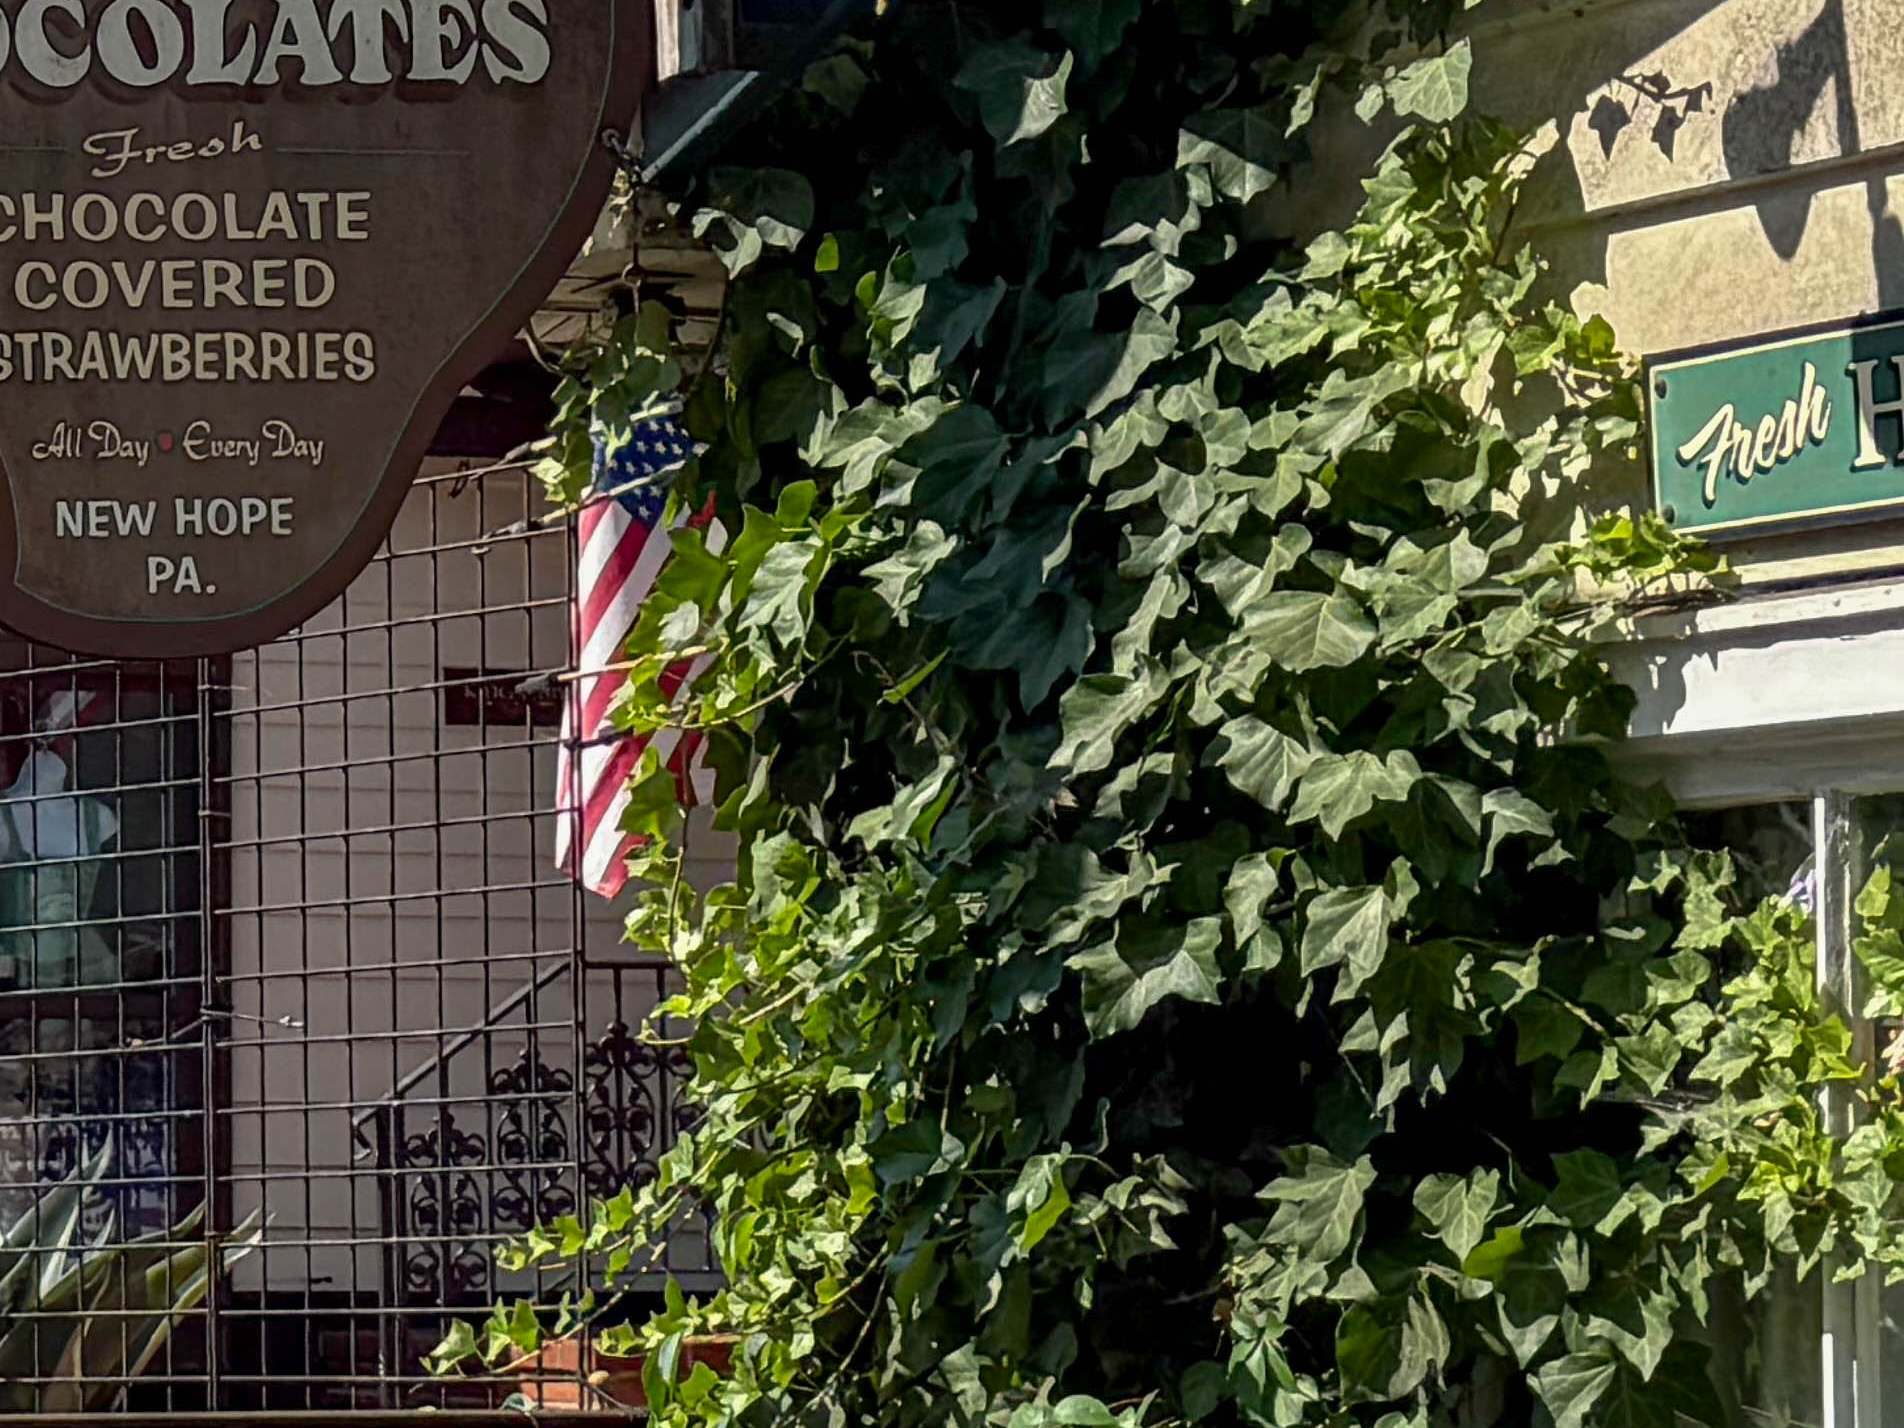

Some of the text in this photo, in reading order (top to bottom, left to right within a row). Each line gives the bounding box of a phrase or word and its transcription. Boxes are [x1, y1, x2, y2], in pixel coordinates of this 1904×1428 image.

[82, 118, 264, 178] Fresh
[14, 258, 337, 310] COVERED
[32, 420, 325, 466] All Day Every Day
[1677, 361, 1832, 502] Fresh
[55, 497, 295, 538] NEW HOPE
[147, 555, 218, 595] PA.
